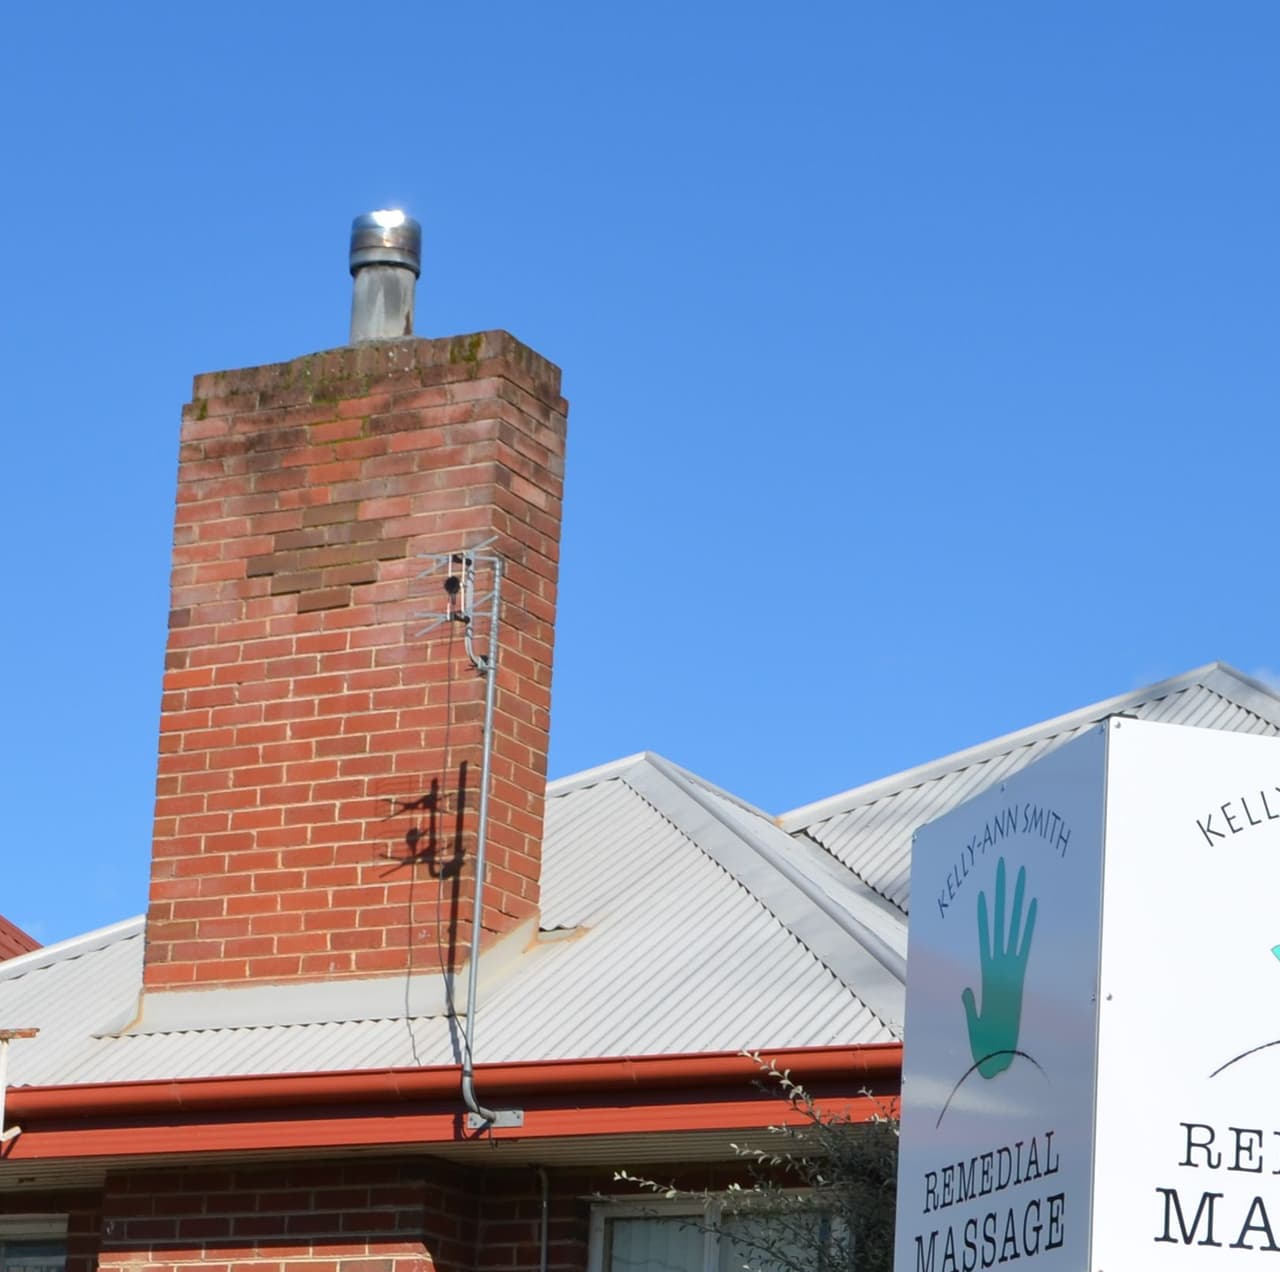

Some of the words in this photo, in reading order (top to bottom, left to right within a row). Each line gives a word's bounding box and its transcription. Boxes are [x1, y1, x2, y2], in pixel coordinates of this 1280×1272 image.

[937, 804, 1019, 919] KELLY-ANN
[1022, 803, 1071, 858] SMITH
[923, 1130, 1059, 1214] REMEDIAL
